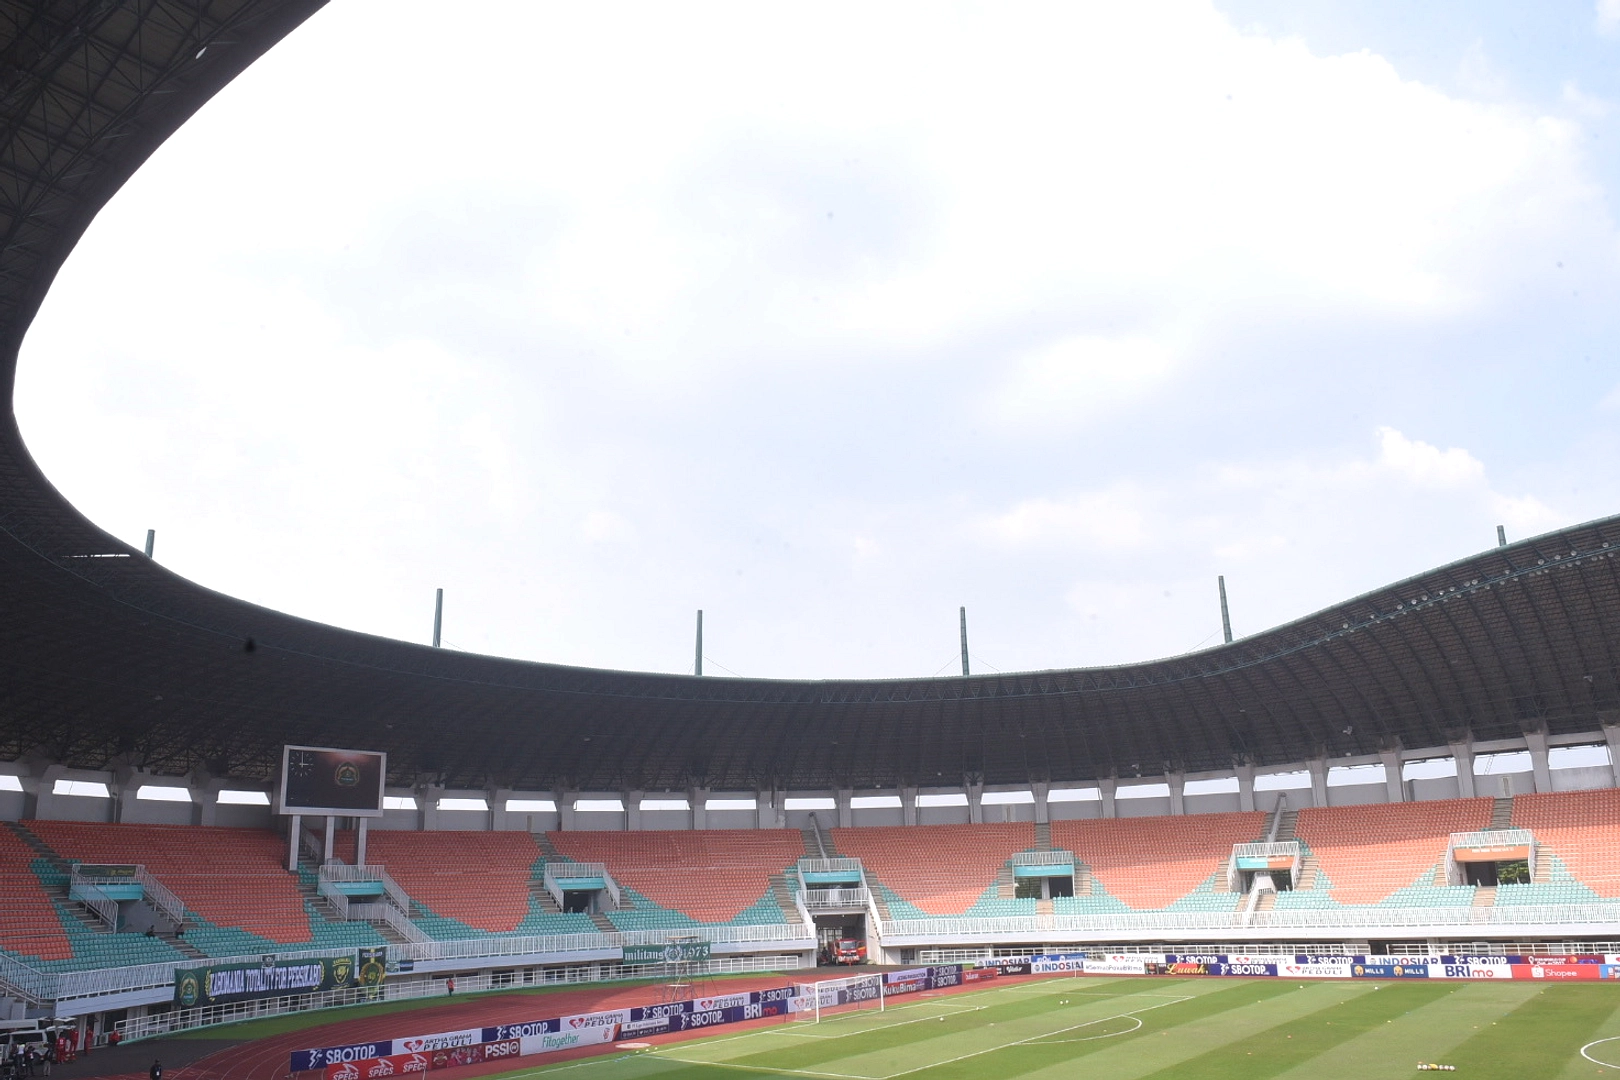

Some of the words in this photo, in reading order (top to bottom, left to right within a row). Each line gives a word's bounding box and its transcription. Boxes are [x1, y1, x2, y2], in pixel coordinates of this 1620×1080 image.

[624, 949, 664, 961] militans
[684, 946, 709, 959] 1973
[1318, 957, 1354, 965] SBOTOP
[1379, 957, 1438, 965] INDOSIAR
[1466, 956, 1507, 965] SBOTOP
[1166, 964, 1206, 975] Luwak
[1231, 964, 1265, 975] SBOTOP
[1545, 968, 1578, 978] Shopee
[210, 970, 244, 997] KABOMANIA
[246, 968, 274, 992] TOTALITY
[275, 967, 287, 990] FOR
[288, 965, 321, 989] PERSIKABO
[767, 988, 793, 1002] SBOTOP
[652, 1004, 684, 1018] SBOTOP
[584, 1017, 624, 1028] PEDULI
[691, 1010, 723, 1027] SBOTOP
[509, 1022, 548, 1040] SBOTOP
[423, 1038, 473, 1052] PEDULI
[425, 1036, 449, 1045] ARTHA
[449, 1033, 473, 1042] GRAHA
[542, 1032, 580, 1048] Fitogether
[326, 1045, 377, 1065] SBOTOP
[485, 1043, 510, 1059] PSSI
[368, 1066, 395, 1078] SPECS
[403, 1061, 428, 1073] SPECS
[333, 1071, 360, 1080] SPECS
